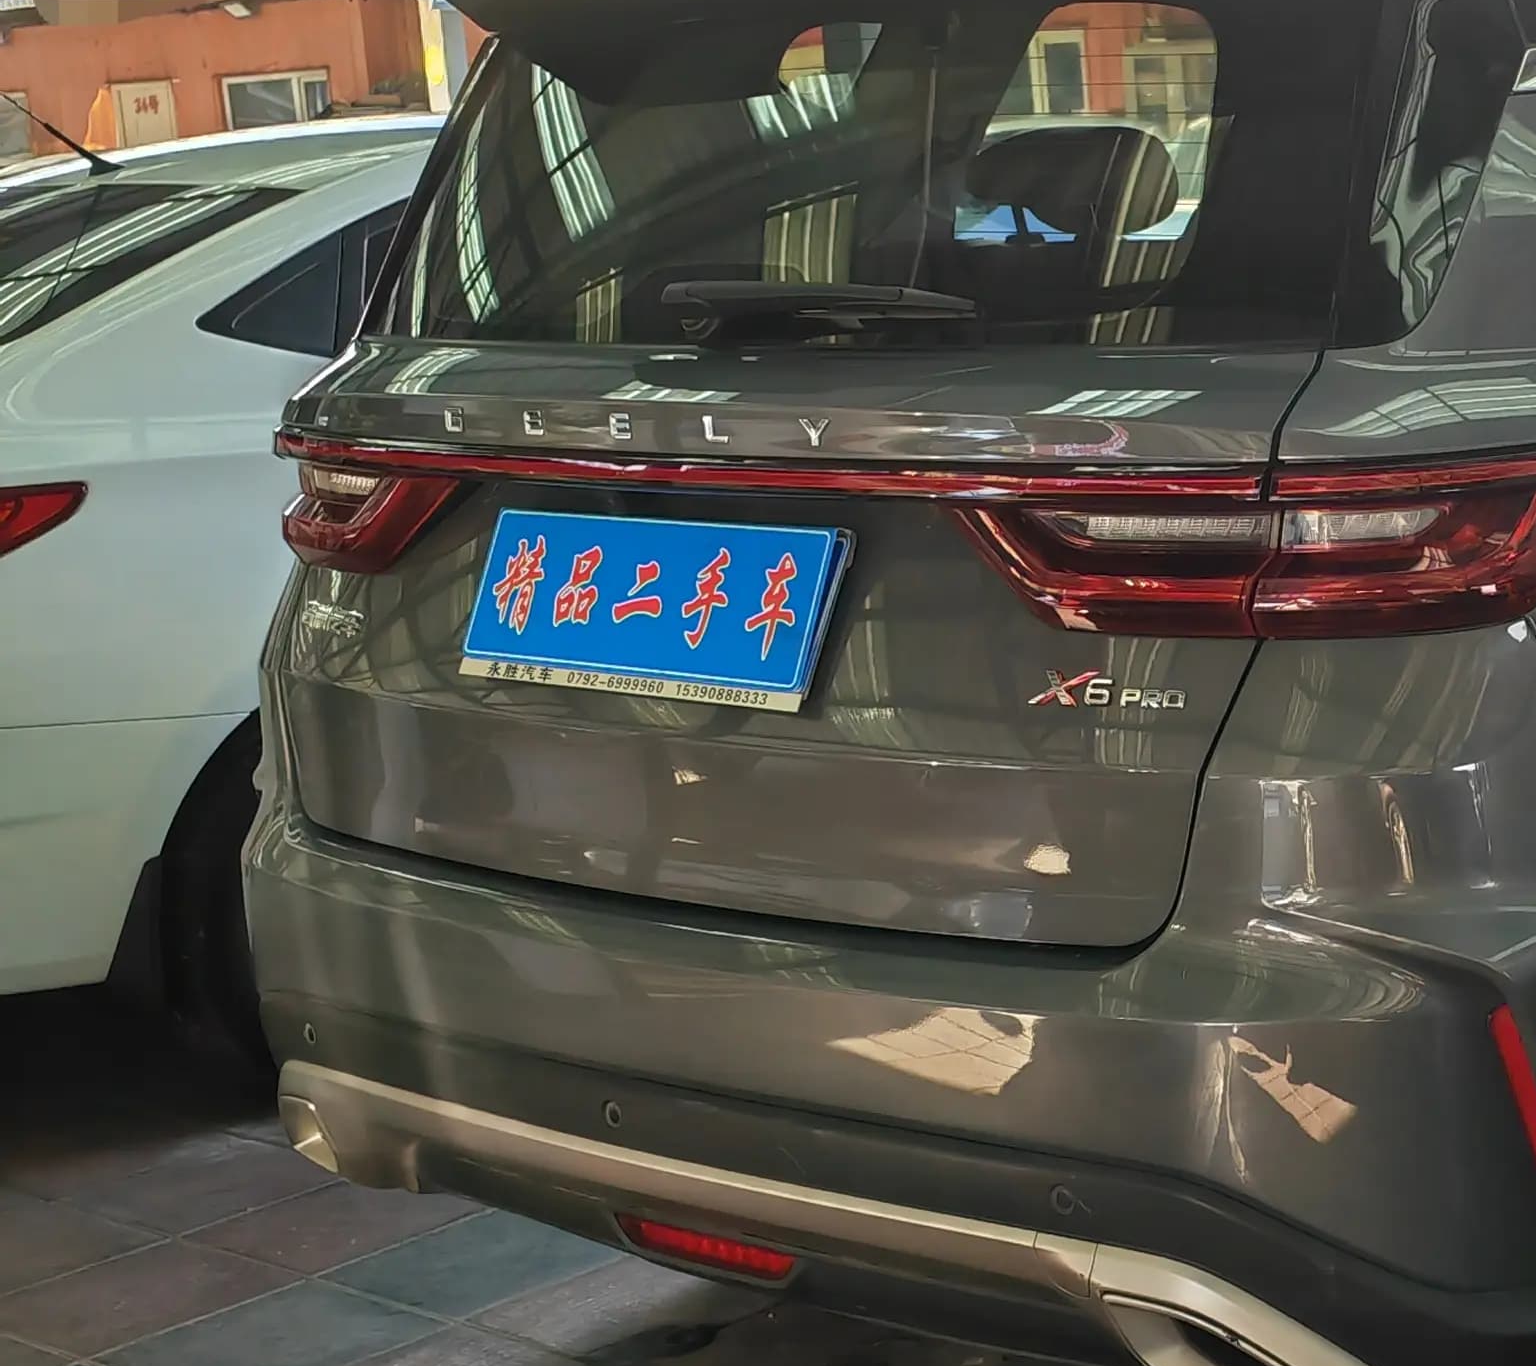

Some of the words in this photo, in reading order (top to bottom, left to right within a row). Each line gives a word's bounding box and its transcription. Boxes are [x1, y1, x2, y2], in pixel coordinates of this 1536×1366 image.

[443, 406, 831, 448] GEELY
[493, 535, 797, 661] 精品二手车
[487, 662, 554, 682] 永胜汽车
[566, 671, 665, 694] 0792-6999960
[676, 683, 769, 705] 15390888333
[1119, 688, 1188, 710] PRO
